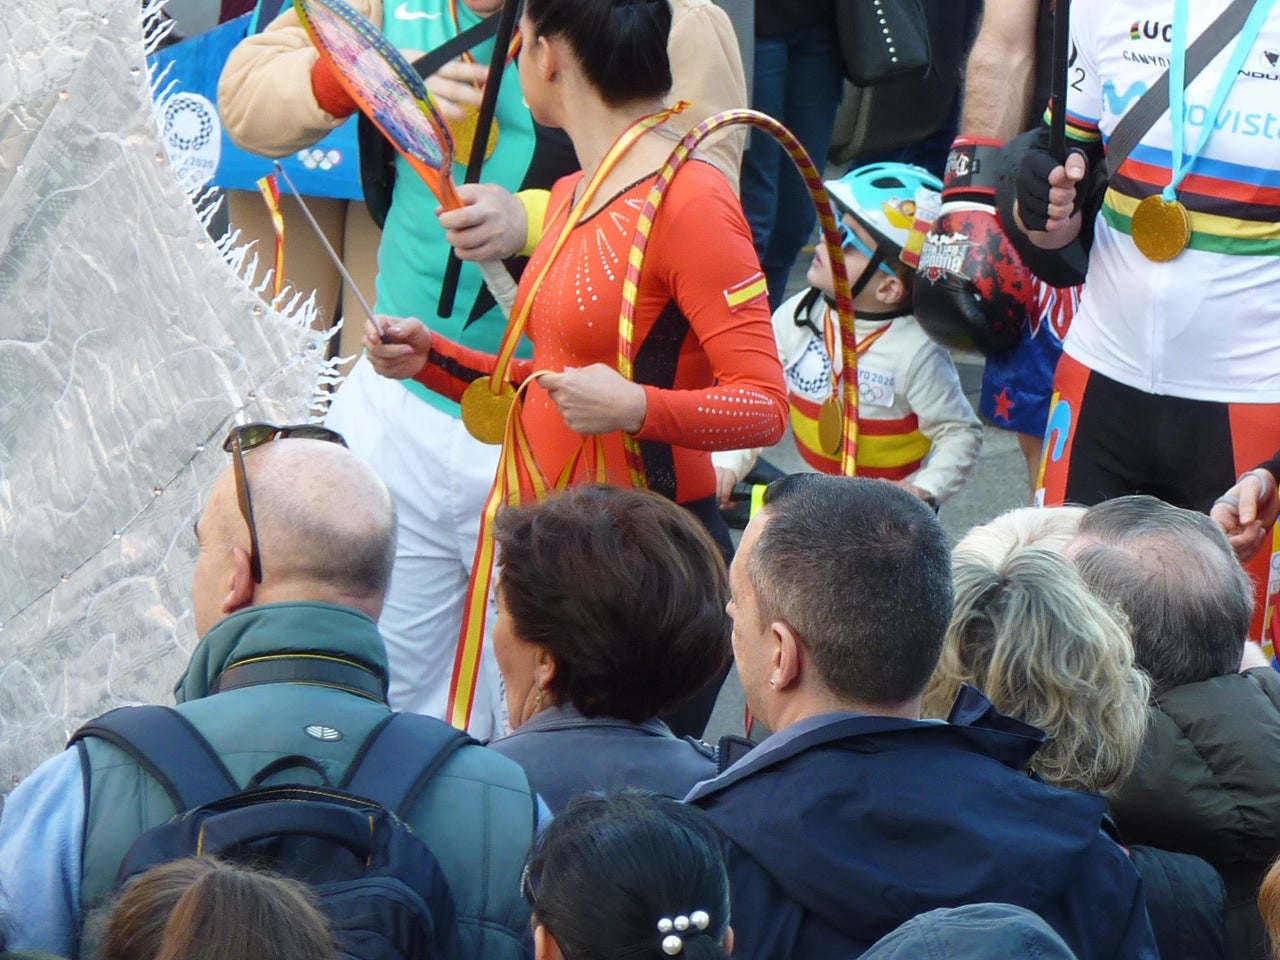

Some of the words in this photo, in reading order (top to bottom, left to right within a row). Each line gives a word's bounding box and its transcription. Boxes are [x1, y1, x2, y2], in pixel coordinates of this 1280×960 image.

[1142, 19, 1173, 43] UC
[1122, 49, 1171, 69] CANYO
[871, 373, 895, 387] 2020
